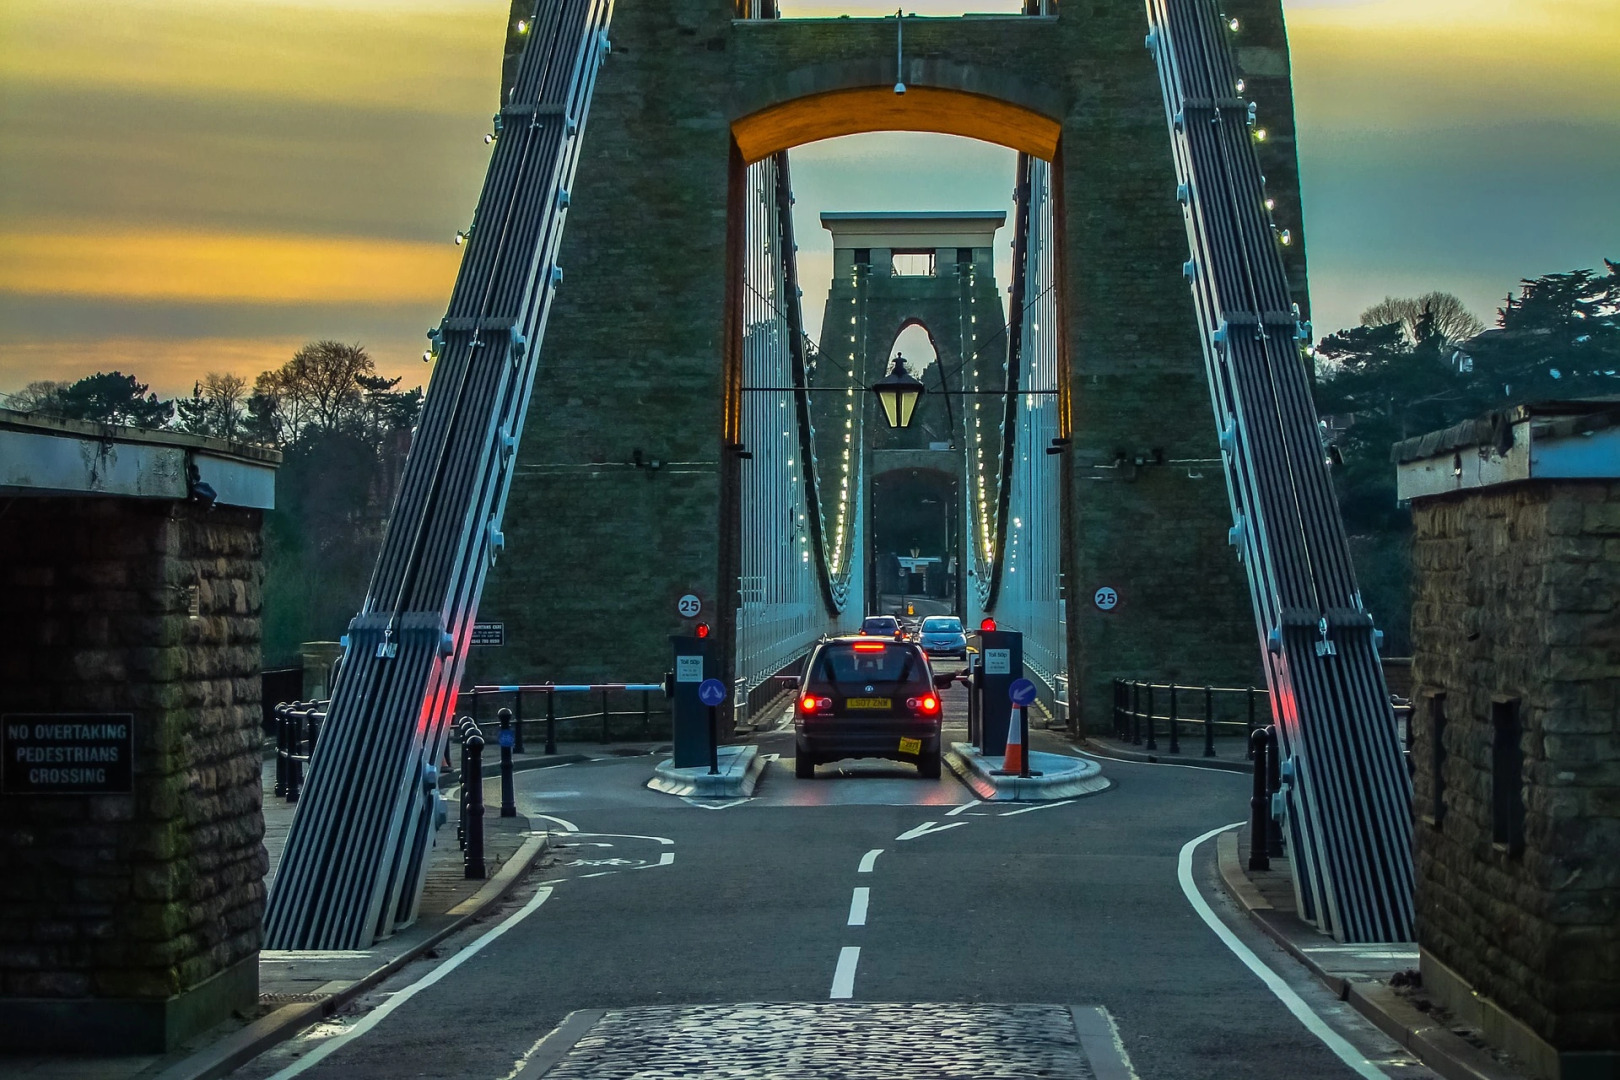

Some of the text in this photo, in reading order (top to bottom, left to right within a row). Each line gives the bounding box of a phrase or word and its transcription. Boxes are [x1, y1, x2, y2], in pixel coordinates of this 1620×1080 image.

[681, 600, 699, 612] 25
[1097, 593, 1115, 604] 25
[8, 724, 127, 740] NO OVERTAKING
[16, 746, 118, 762] PEDESTRIANS
[29, 768, 105, 784] CROSSING
